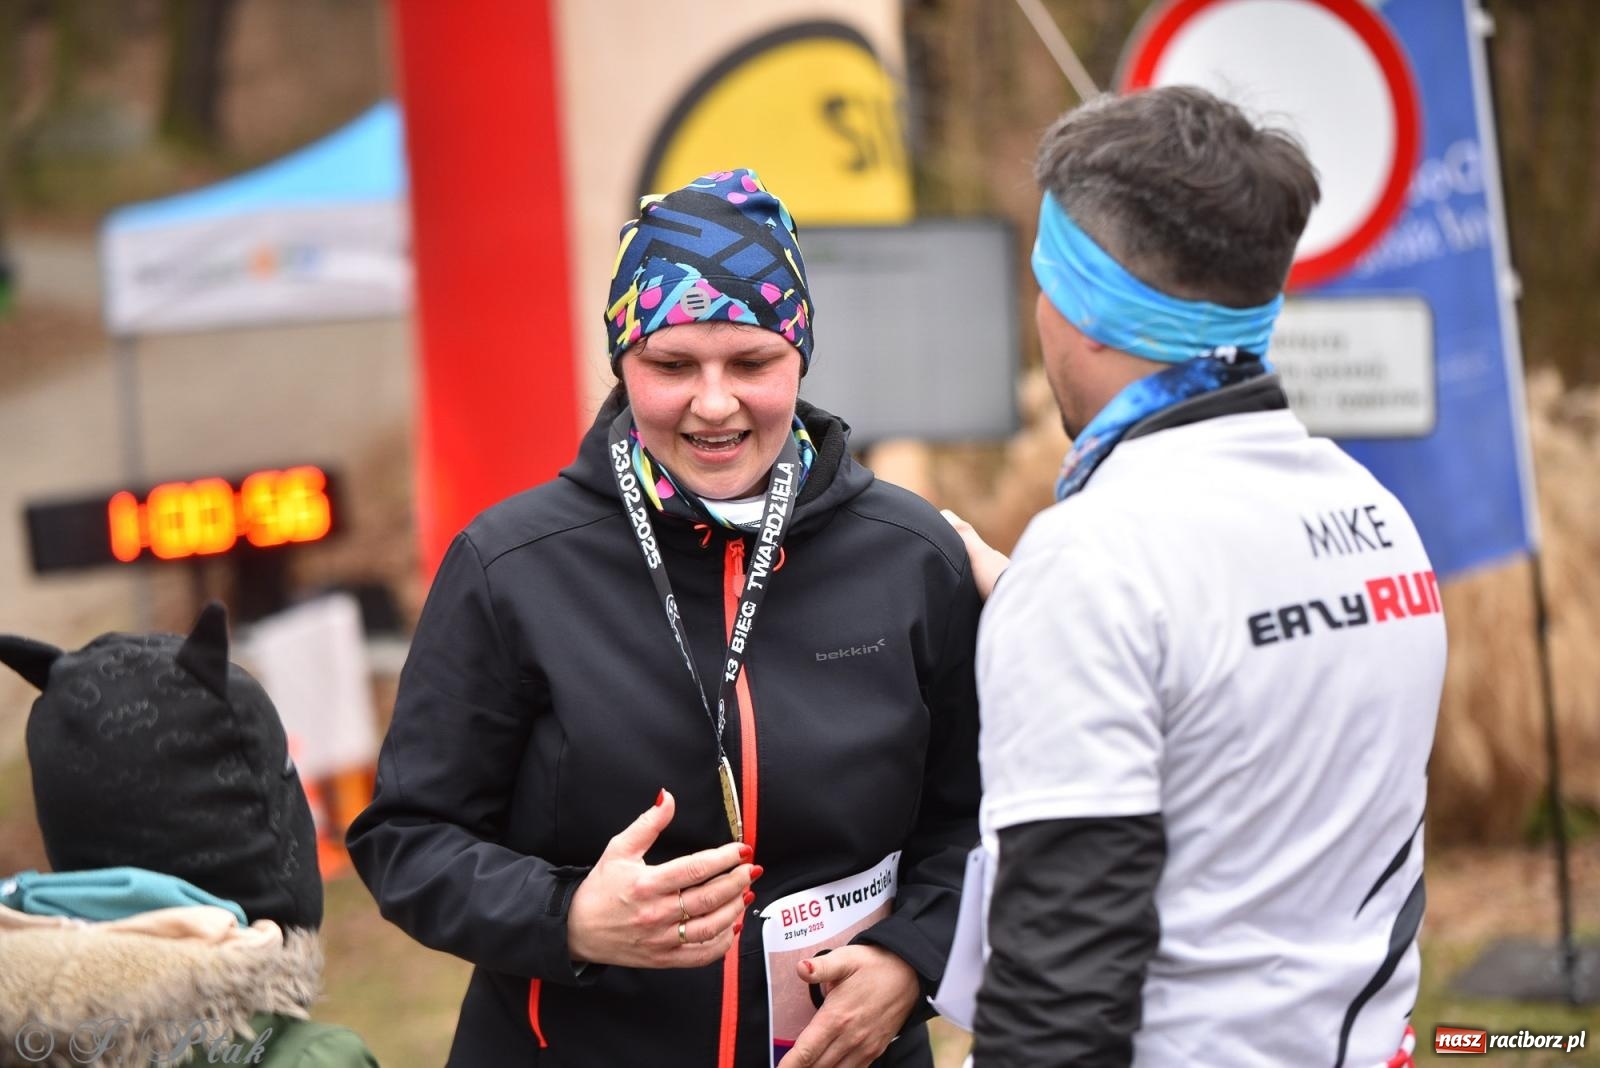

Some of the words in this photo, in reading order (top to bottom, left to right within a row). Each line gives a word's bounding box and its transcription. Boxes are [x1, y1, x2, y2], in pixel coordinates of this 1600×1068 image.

[611, 440, 662, 569] 23.02.2025
[748, 462, 794, 590] TWARDZIELA
[1301, 504, 1393, 558] MIKE
[731, 600, 756, 654] BIEG
[725, 658, 739, 682] 13
[780, 900, 822, 927] BIEG
[825, 869, 892, 912] Twardziela
[784, 932, 793, 940] 23
[794, 927, 807, 938] luty
[808, 921, 825, 933] 2025
